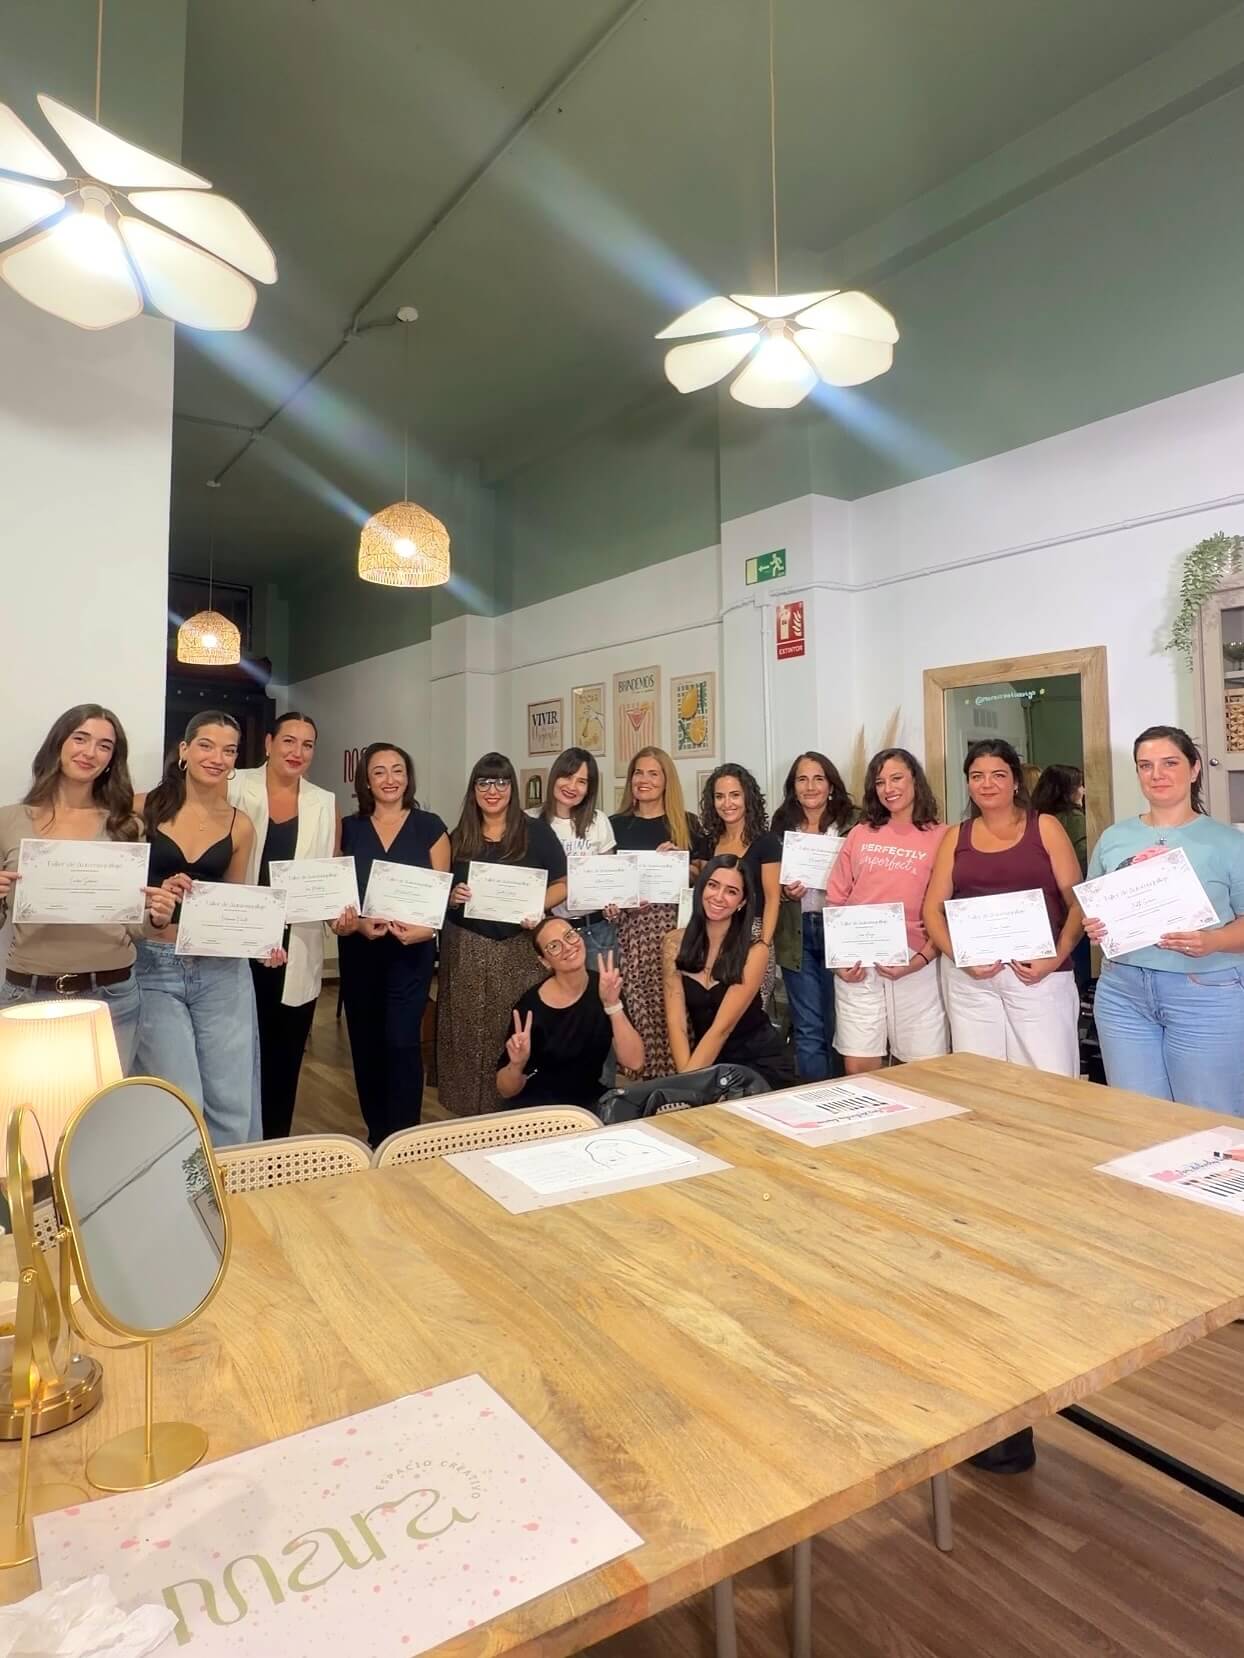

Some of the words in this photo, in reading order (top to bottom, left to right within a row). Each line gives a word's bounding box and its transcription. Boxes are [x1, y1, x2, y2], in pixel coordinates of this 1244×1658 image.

[532, 711, 558, 726] VIVIR
[861, 843, 928, 860] PERFECTLY
[375, 1459, 432, 1490] ESPACIO
[440, 1459, 481, 1499] CREATIVO
